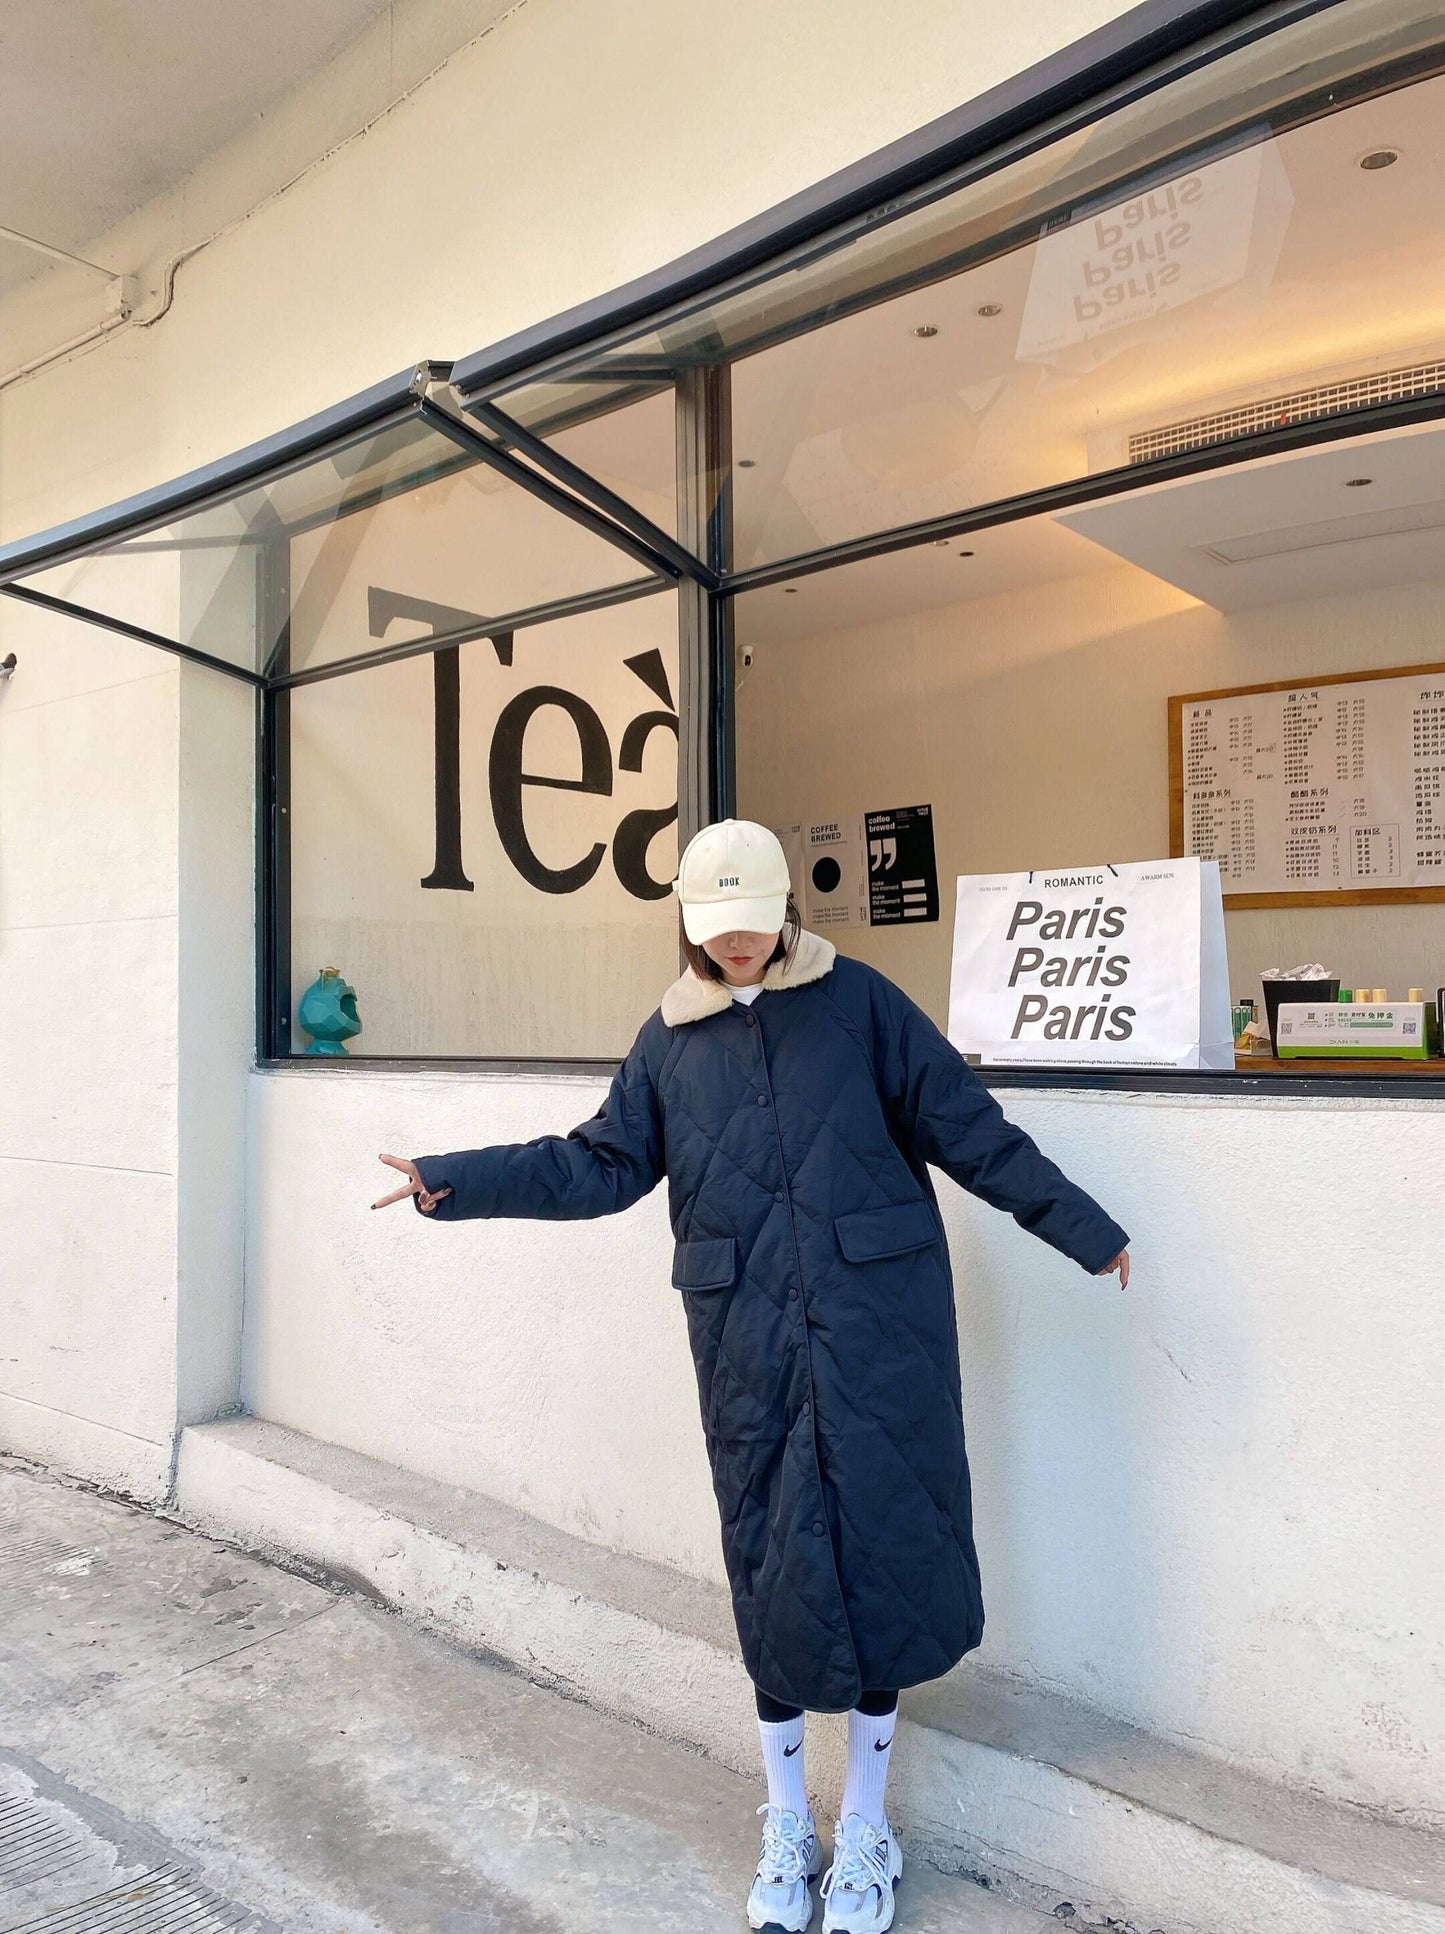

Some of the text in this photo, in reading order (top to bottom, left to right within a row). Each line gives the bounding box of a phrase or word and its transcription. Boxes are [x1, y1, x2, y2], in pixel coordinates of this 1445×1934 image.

[868, 816, 890, 824] coffee
[811, 824, 838, 834] COFFEE
[869, 822, 895, 832] brewed
[811, 833, 841, 843] BREWED
[719, 877, 740, 888] BOOK
[1044, 875, 1104, 888] ROMANTIC
[1006, 897, 1127, 941] Paris
[1007, 945, 1131, 987] Paris
[1010, 994, 1136, 1041] Paris
